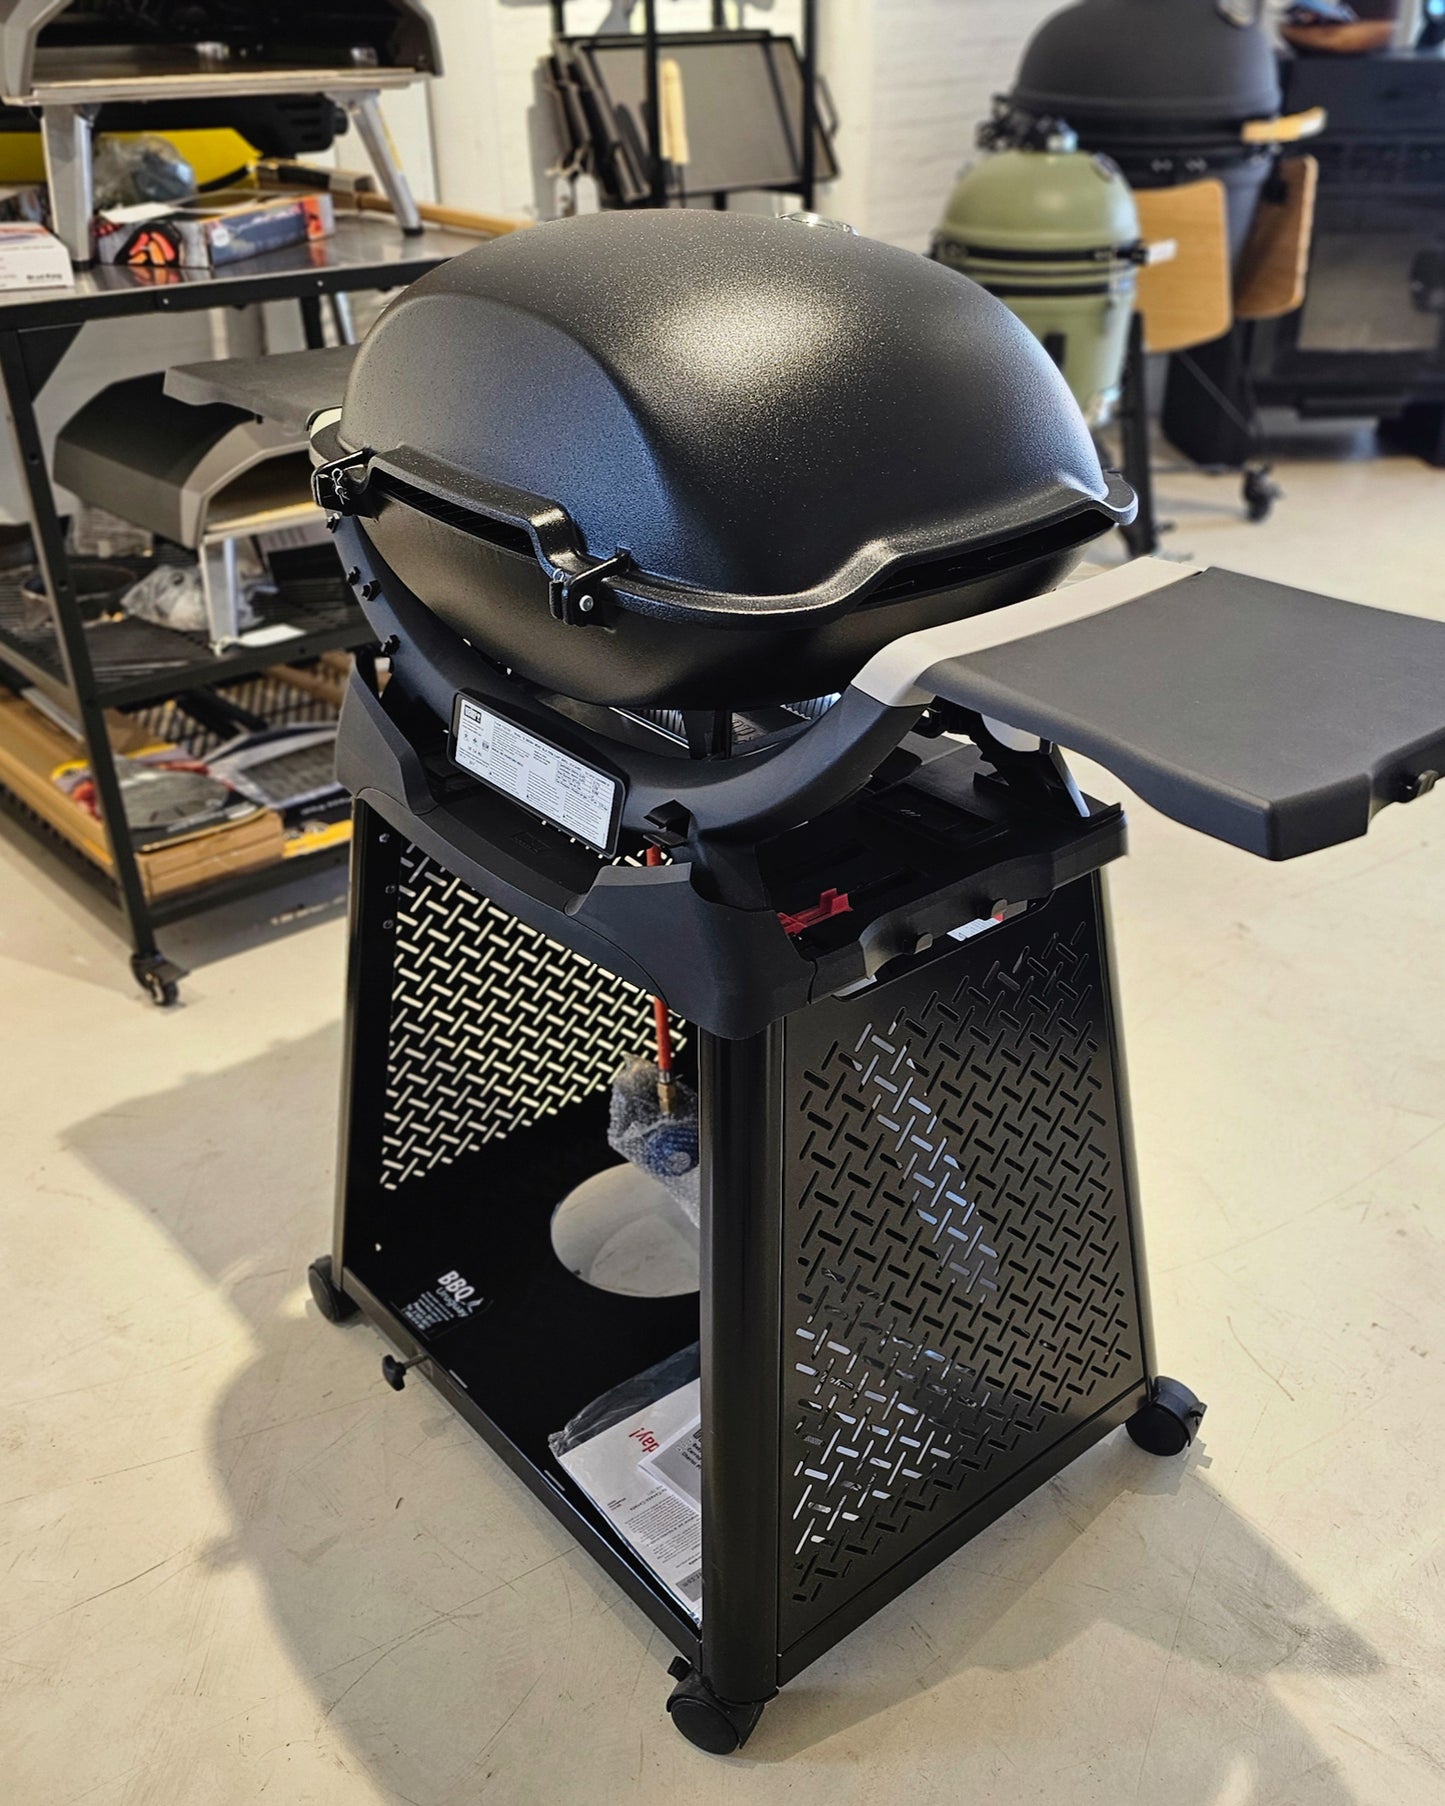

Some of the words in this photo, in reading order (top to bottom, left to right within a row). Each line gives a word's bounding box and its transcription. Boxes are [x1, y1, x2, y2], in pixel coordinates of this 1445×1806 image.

[435, 1286, 468, 1318] Uruguay
[437, 1270, 475, 1302] BBQ
[628, 1427, 660, 1453] day!
